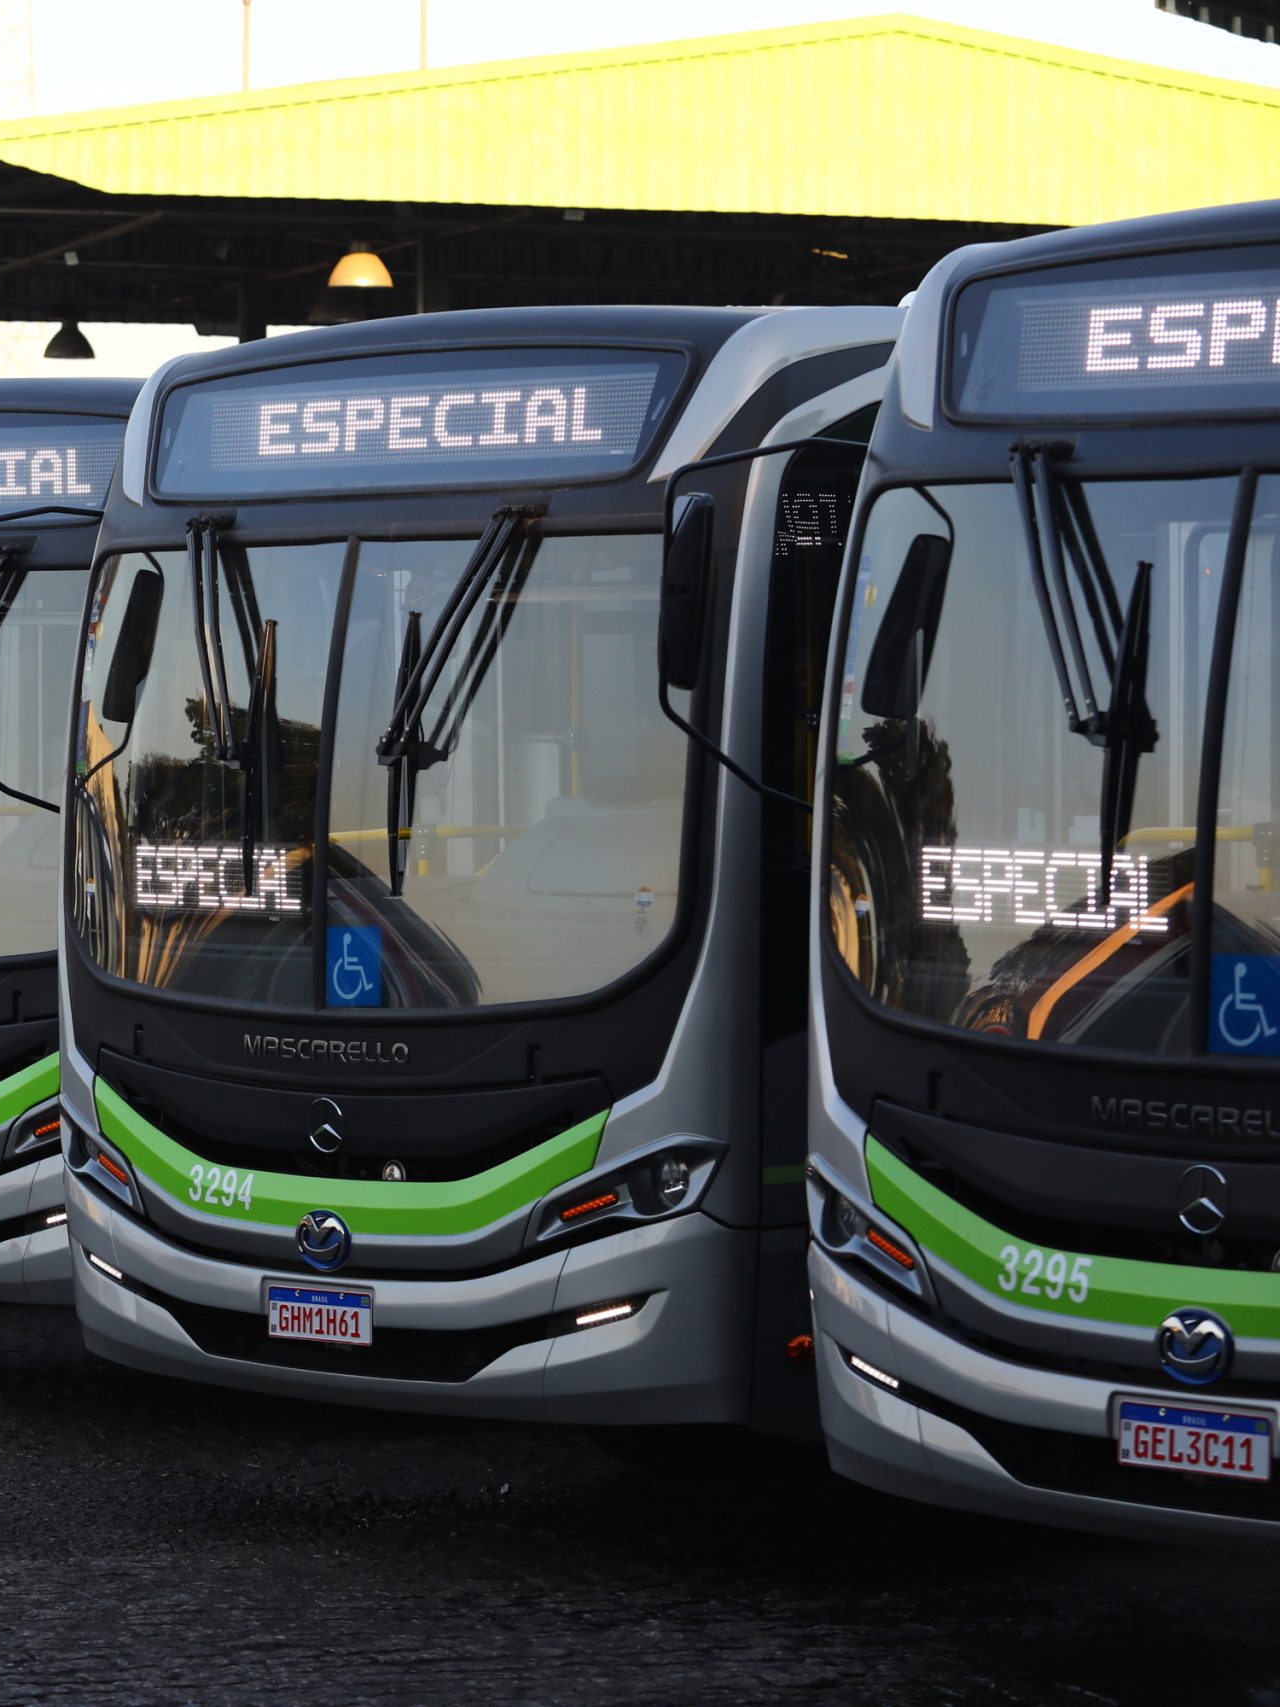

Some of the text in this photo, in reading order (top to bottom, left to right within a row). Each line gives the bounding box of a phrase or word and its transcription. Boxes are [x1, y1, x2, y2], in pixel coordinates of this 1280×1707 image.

[258, 387, 603, 455] ESPECIAL
[922, 847, 1168, 931] ESPECIAL
[244, 1035, 409, 1063] MASCARELLO
[188, 1164, 253, 1211] 3294
[998, 1245, 1093, 1303] 3295
[279, 1304, 361, 1338] GHM1H61
[1182, 1415, 1207, 1426] BRASIL
[1134, 1424, 1254, 1472] GEL3C11
